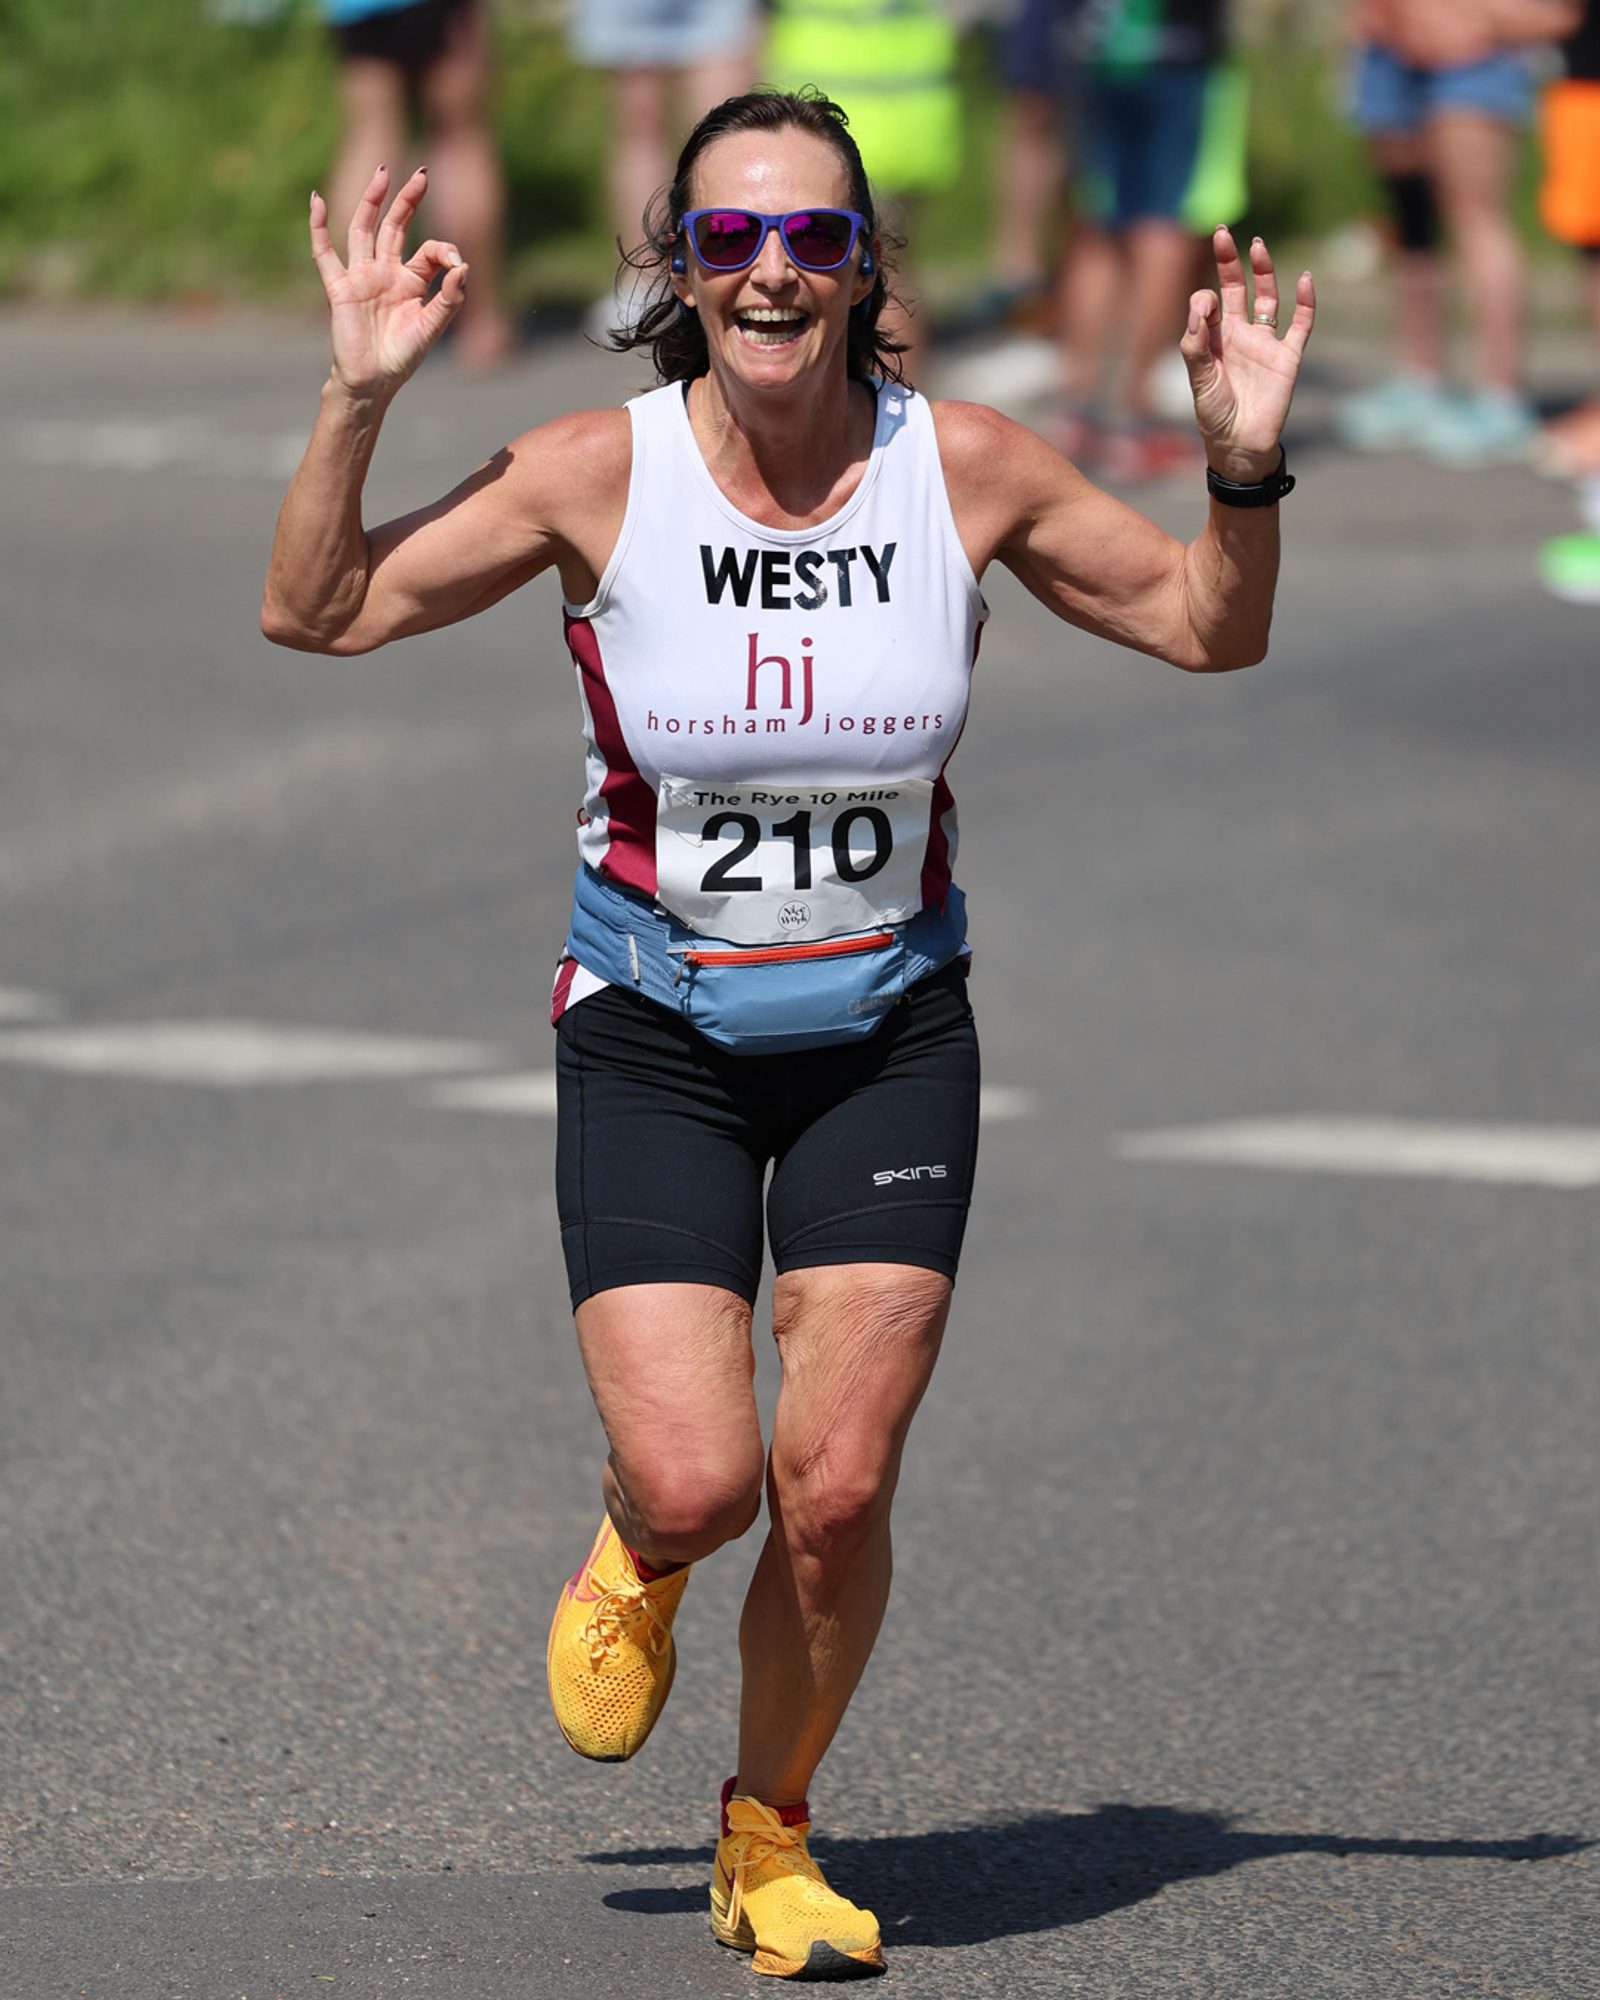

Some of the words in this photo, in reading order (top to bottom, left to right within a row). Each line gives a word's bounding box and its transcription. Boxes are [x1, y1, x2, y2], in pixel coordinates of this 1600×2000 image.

[700, 542, 897, 610] WESTY
[745, 632, 814, 726] hj
[648, 711, 786, 735] horsham
[824, 712, 943, 735] joggers
[694, 791, 741, 806] The
[751, 791, 800, 805] Rye
[809, 792, 837, 805] 10
[847, 790, 900, 801] Mile
[700, 806, 893, 892] 210
